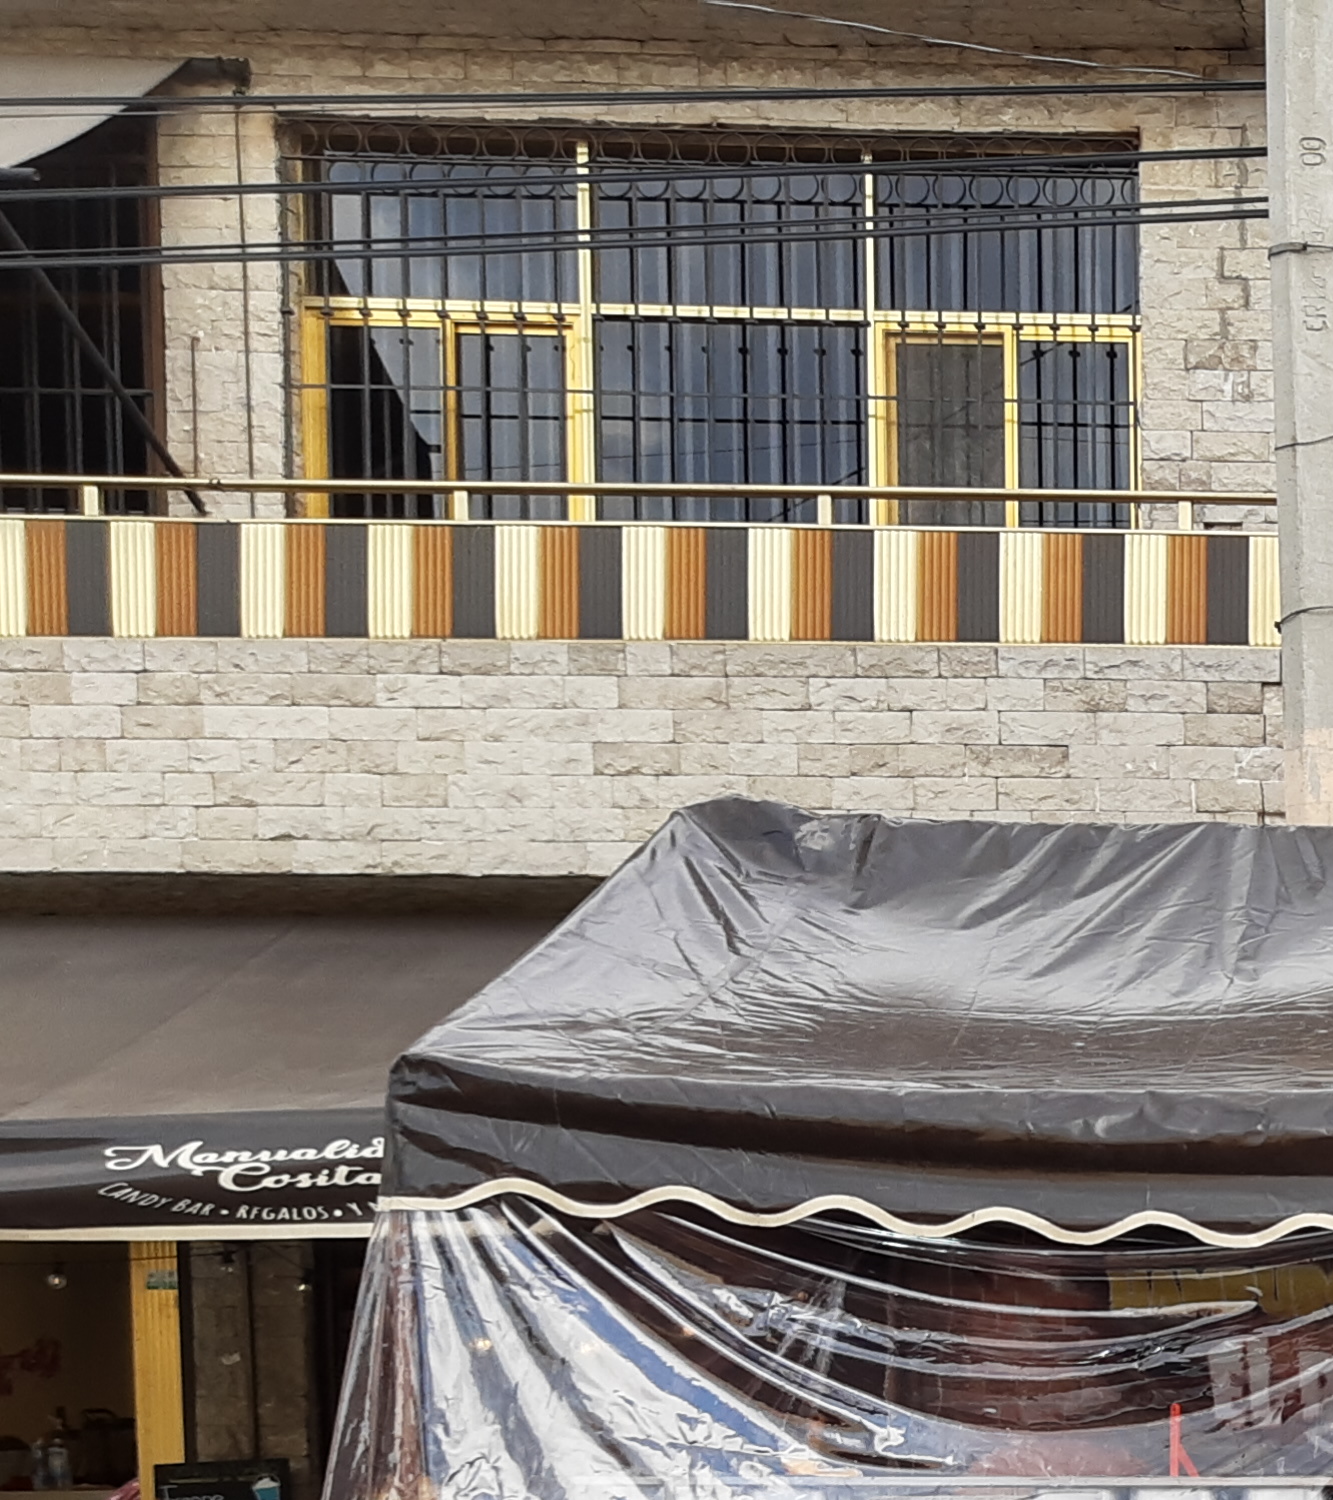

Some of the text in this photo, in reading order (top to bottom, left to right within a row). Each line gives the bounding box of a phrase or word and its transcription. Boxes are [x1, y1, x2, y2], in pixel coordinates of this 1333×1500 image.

[97, 1182, 173, 1210] CANDY
[170, 1199, 216, 1217] BAR
[346, 1202, 363, 1217] Y
